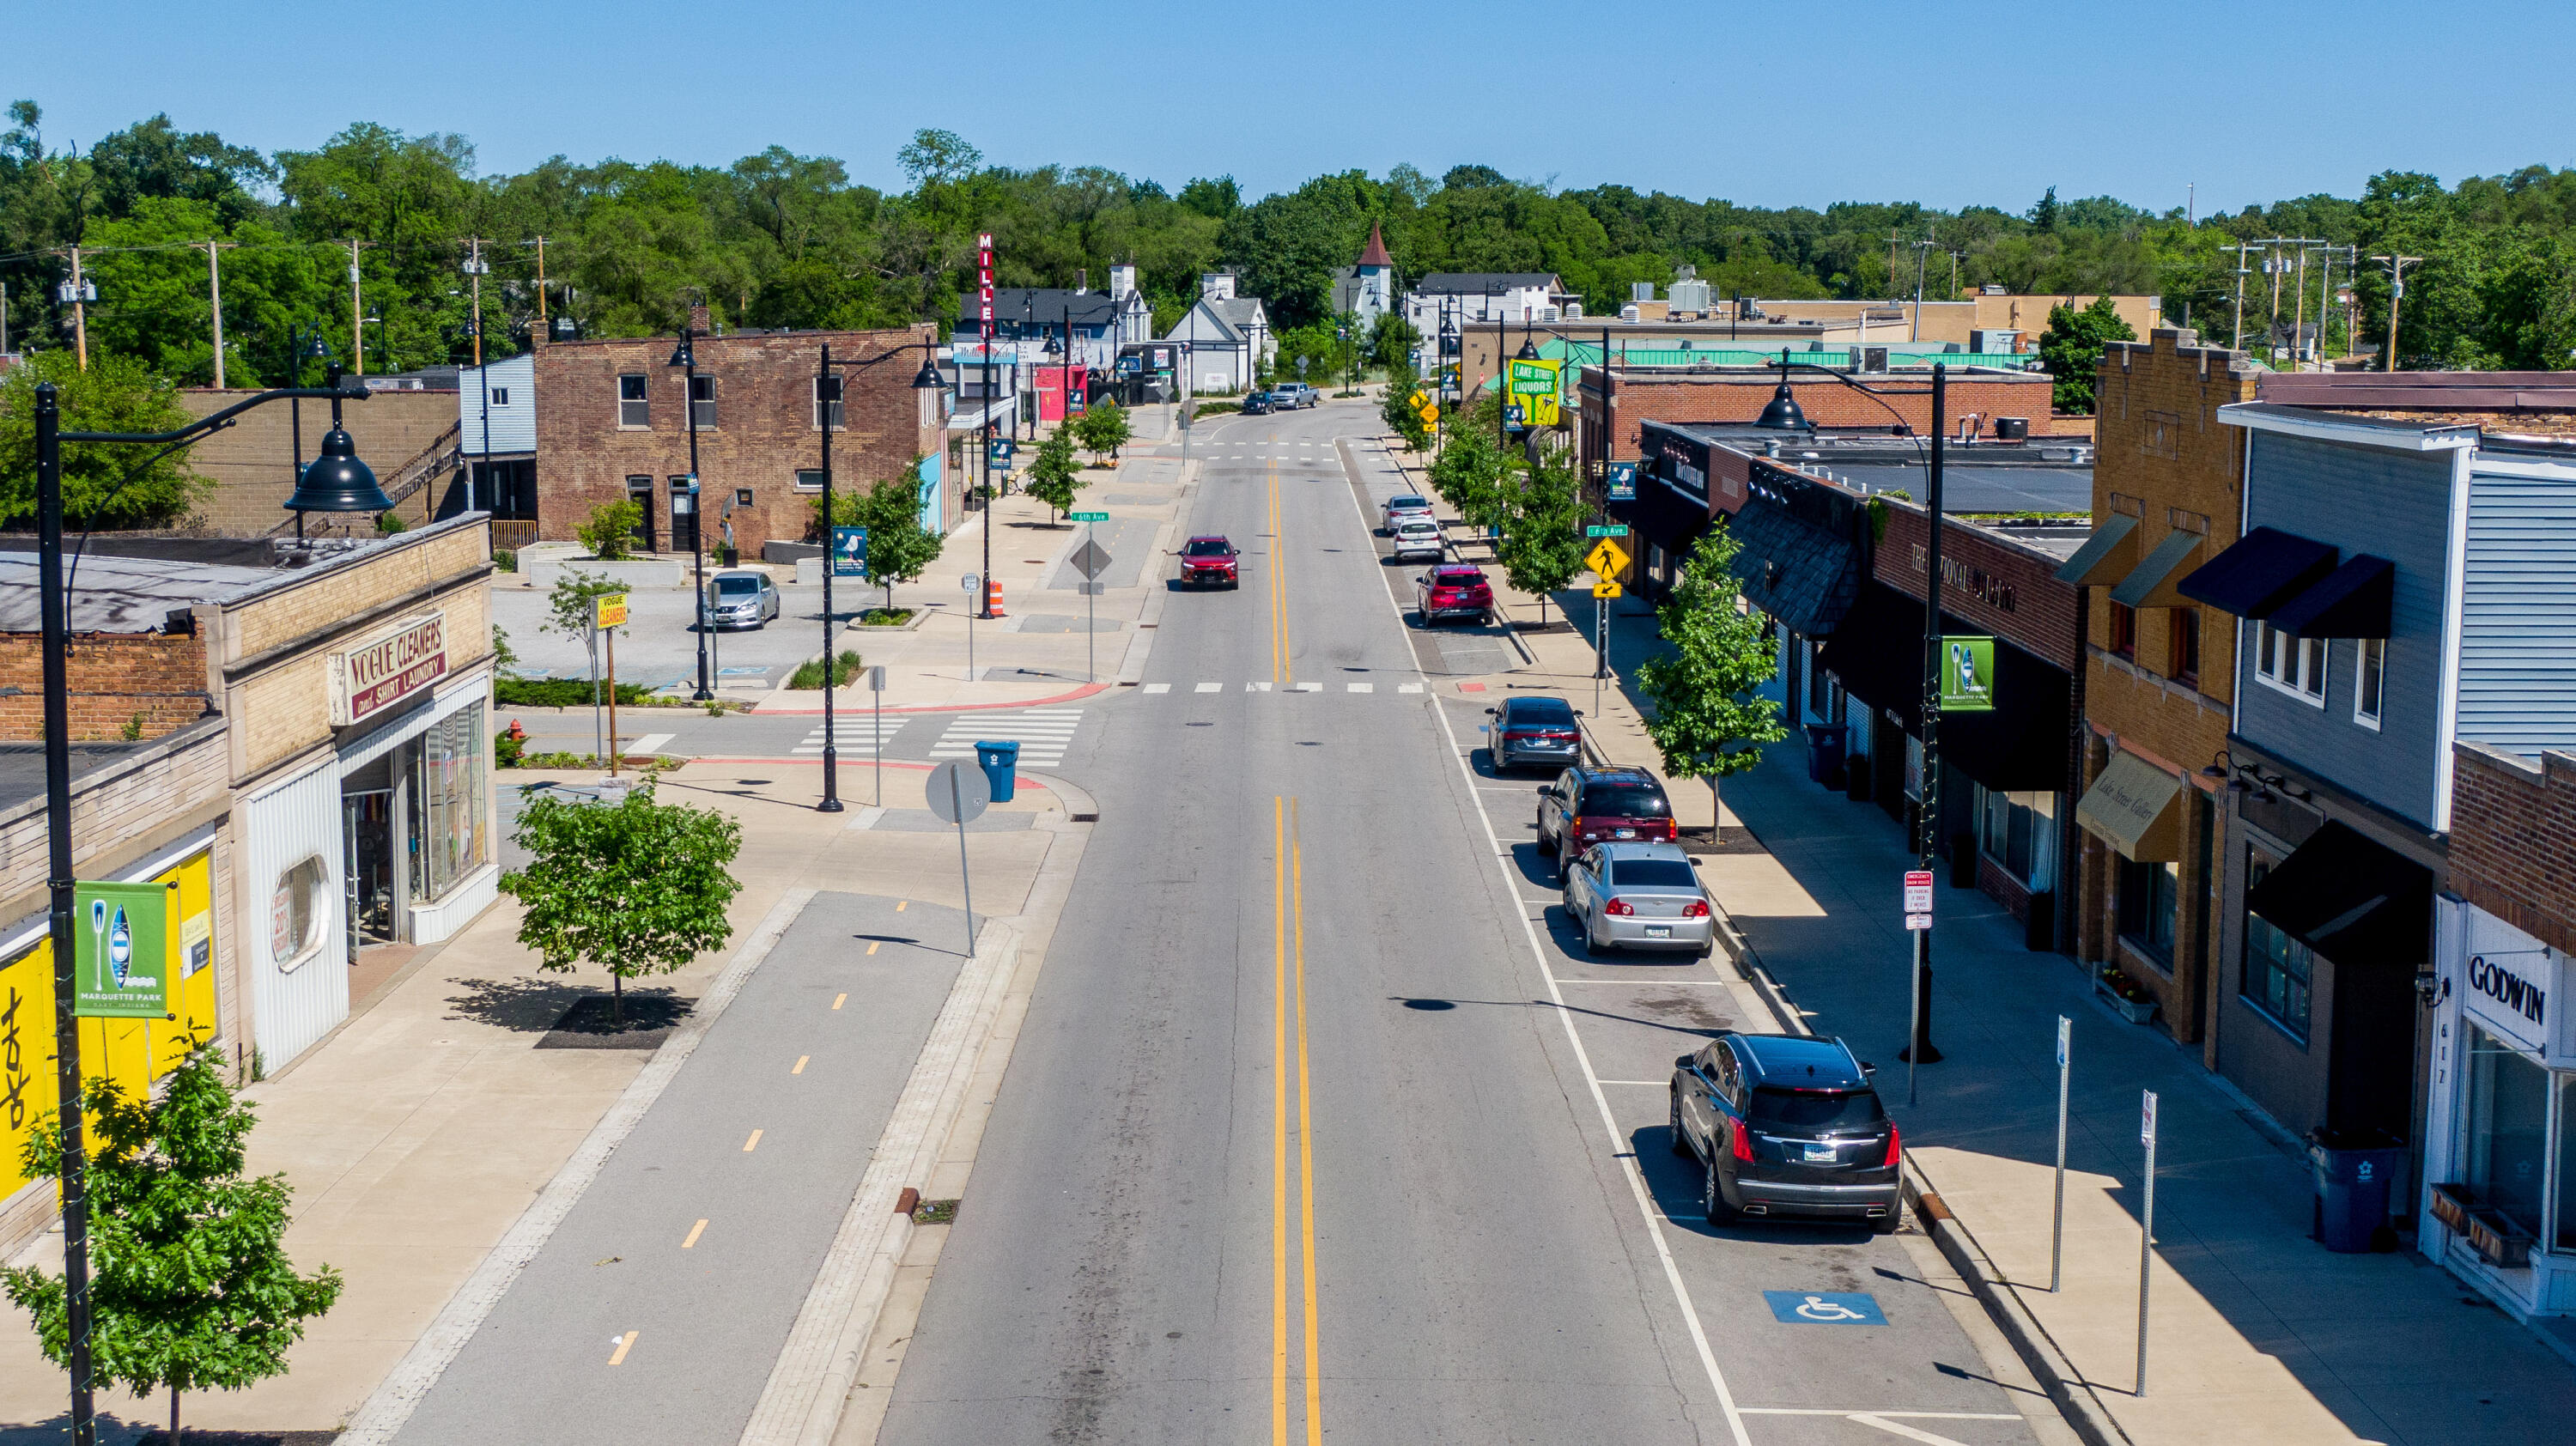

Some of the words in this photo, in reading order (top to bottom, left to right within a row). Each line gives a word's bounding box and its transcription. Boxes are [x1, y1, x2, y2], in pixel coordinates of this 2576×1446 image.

[1515, 381, 1552, 392] LIQUORS
[1516, 366, 1533, 379] LAKE
[1534, 369, 1553, 380] STREET
[1911, 543, 1928, 573] THE
[1940, 556, 1967, 592] TIONAL
[598, 606, 627, 625] CLEANERS
[604, 595, 623, 606] VOGUE
[351, 642, 395, 687] VOGUE
[397, 619, 441, 668] CLEANERS
[357, 690, 374, 714] and
[375, 677, 400, 705] SHIRT
[403, 658, 440, 691] LAUNDRY
[2097, 775, 2115, 796] Lake
[2113, 787, 2132, 808] Street
[2130, 798, 2157, 822] Gallery
[2470, 956, 2545, 1026] GODWIN
